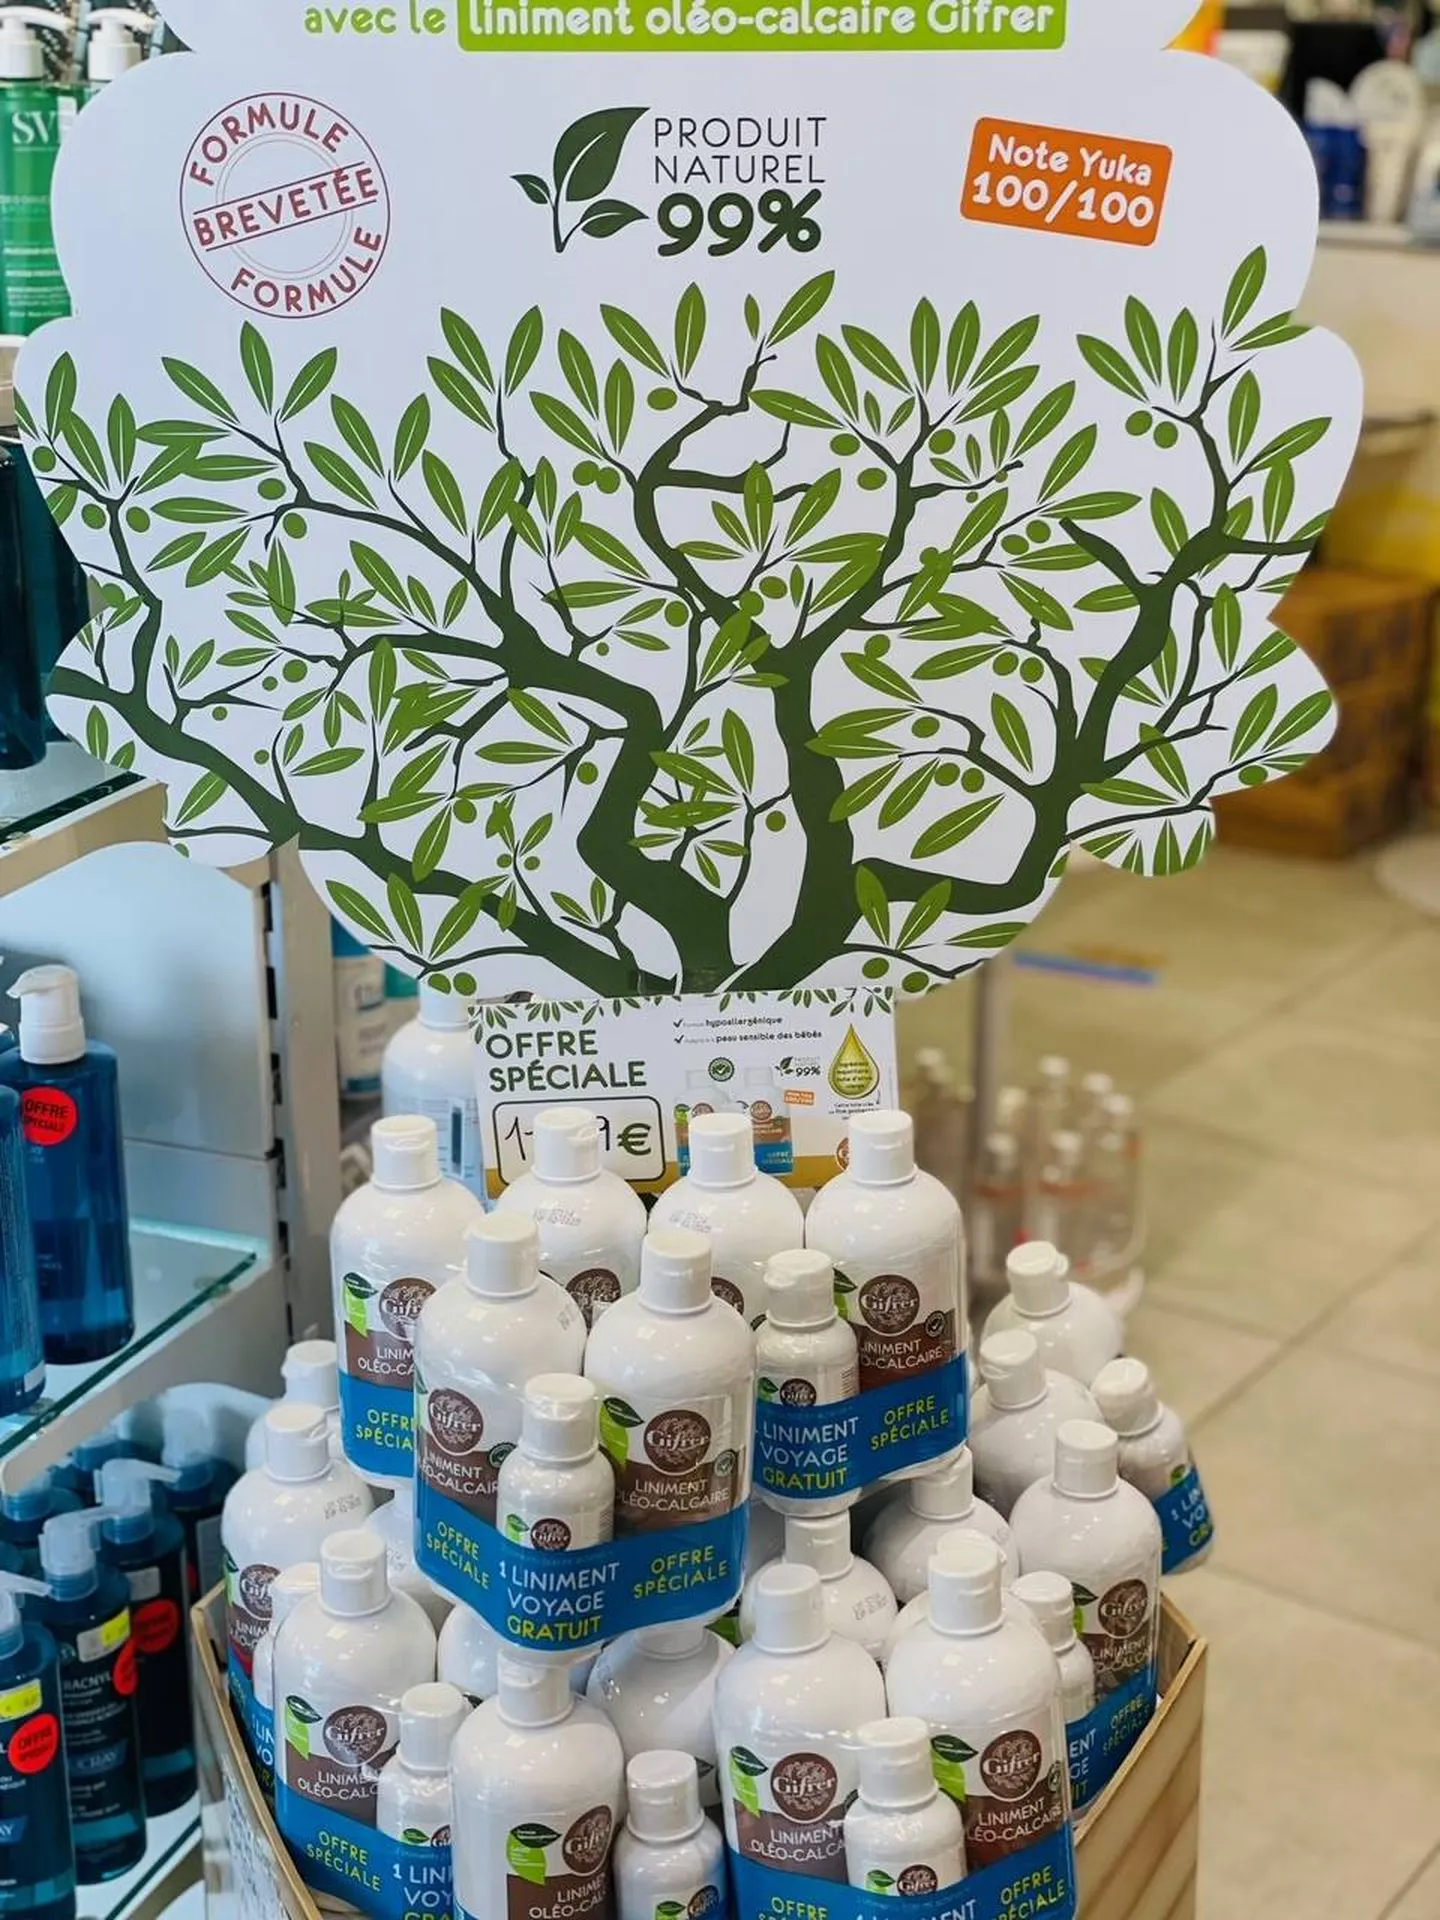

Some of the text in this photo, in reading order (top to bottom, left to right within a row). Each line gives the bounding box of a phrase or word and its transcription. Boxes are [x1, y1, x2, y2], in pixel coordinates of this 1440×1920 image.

[303, 0, 1054, 35] avec le liniment oléo-calcaire Gifrer
[12, 110, 61, 145] SV
[654, 117, 828, 149] PRODUIT
[190, 100, 349, 186] FORMULE
[654, 155, 827, 184] NATUREL
[988, 133, 1152, 187] Note Yuka
[192, 166, 380, 248] BREVETÉE
[972, 172, 1155, 229] 100/100
[657, 188, 822, 258] 99%
[231, 226, 382, 314] FORMULE
[486, 1029, 598, 1059] OFFRE
[489, 1059, 647, 1093] SPÉCIALE
[860, 1291, 918, 1311] Gifrer
[376, 1347, 414, 1361] LINIM
[858, 1339, 922, 1354] INIMENT
[358, 1356, 415, 1376] OLÉO-CA
[429, 1402, 482, 1433] Gifrer
[884, 1395, 936, 1426] OFFRE
[356, 1424, 415, 1451] SPÉCIA
[646, 1429, 710, 1451] Gifrer
[763, 1417, 859, 1445] LINIMENT
[870, 1408, 949, 1451] SPÉCIALE
[760, 1444, 848, 1468] VOYAGE
[635, 1479, 709, 1496] LINIMENT
[763, 1467, 848, 1490] GRATUIT
[437, 1521, 480, 1561] OFFRE
[427, 1533, 490, 1589] SPÉCIALE
[651, 1546, 715, 1574] OFFRE
[499, 1561, 620, 1592] 1 LINIMENT
[633, 1561, 728, 1598] SPÉCIALE
[508, 1590, 604, 1617] VOYAGE
[507, 1615, 603, 1641] GRATUIT
[325, 1726, 385, 1743] Gifrer
[983, 1751, 1041, 1776] Gifrer
[297, 1777, 378, 1799] OLÉO-CALC
[773, 1773, 837, 1796] Gifrer
[978, 1797, 1045, 1826] LINIMENT
[319, 1831, 368, 1866] OFFRE
[750, 1838, 846, 1863] OLÉO-CALCA
[306, 1844, 381, 1892] SPÉCIALE
[393, 1864, 402, 1879] 1
[1000, 1866, 1052, 1905] OFFRE
[771, 1896, 828, 1920] OFFRE
